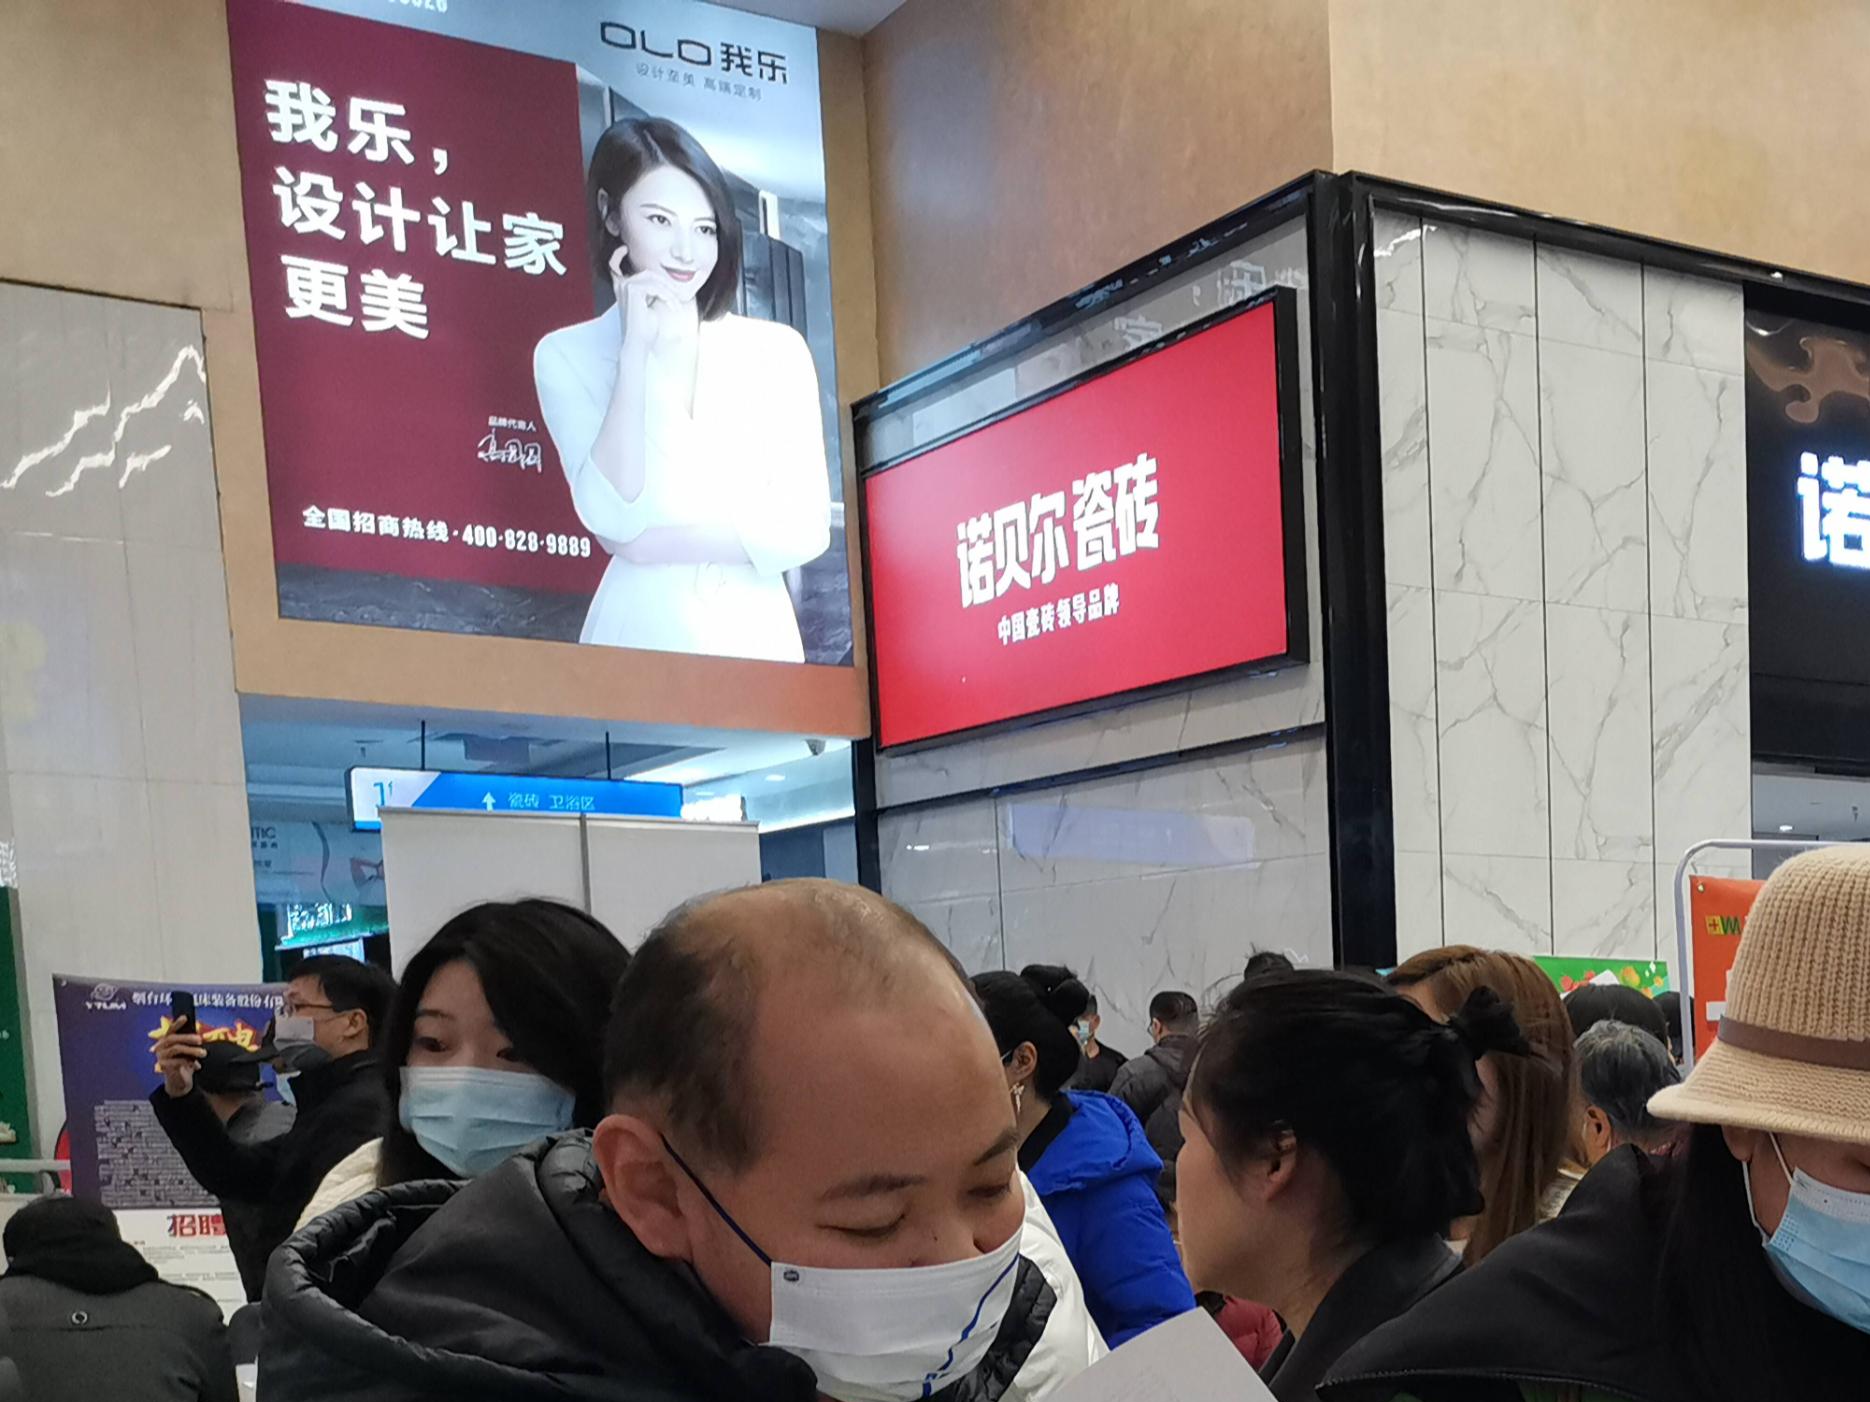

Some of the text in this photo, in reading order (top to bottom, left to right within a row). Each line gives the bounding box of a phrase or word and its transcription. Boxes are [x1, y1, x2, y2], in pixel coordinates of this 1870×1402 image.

[720, 42, 788, 84] 我乐
[272, 166, 568, 277] 设计让家
[280, 254, 430, 340] 更美
[997, 582, 1121, 646] 中国瓷砖领导品牌
